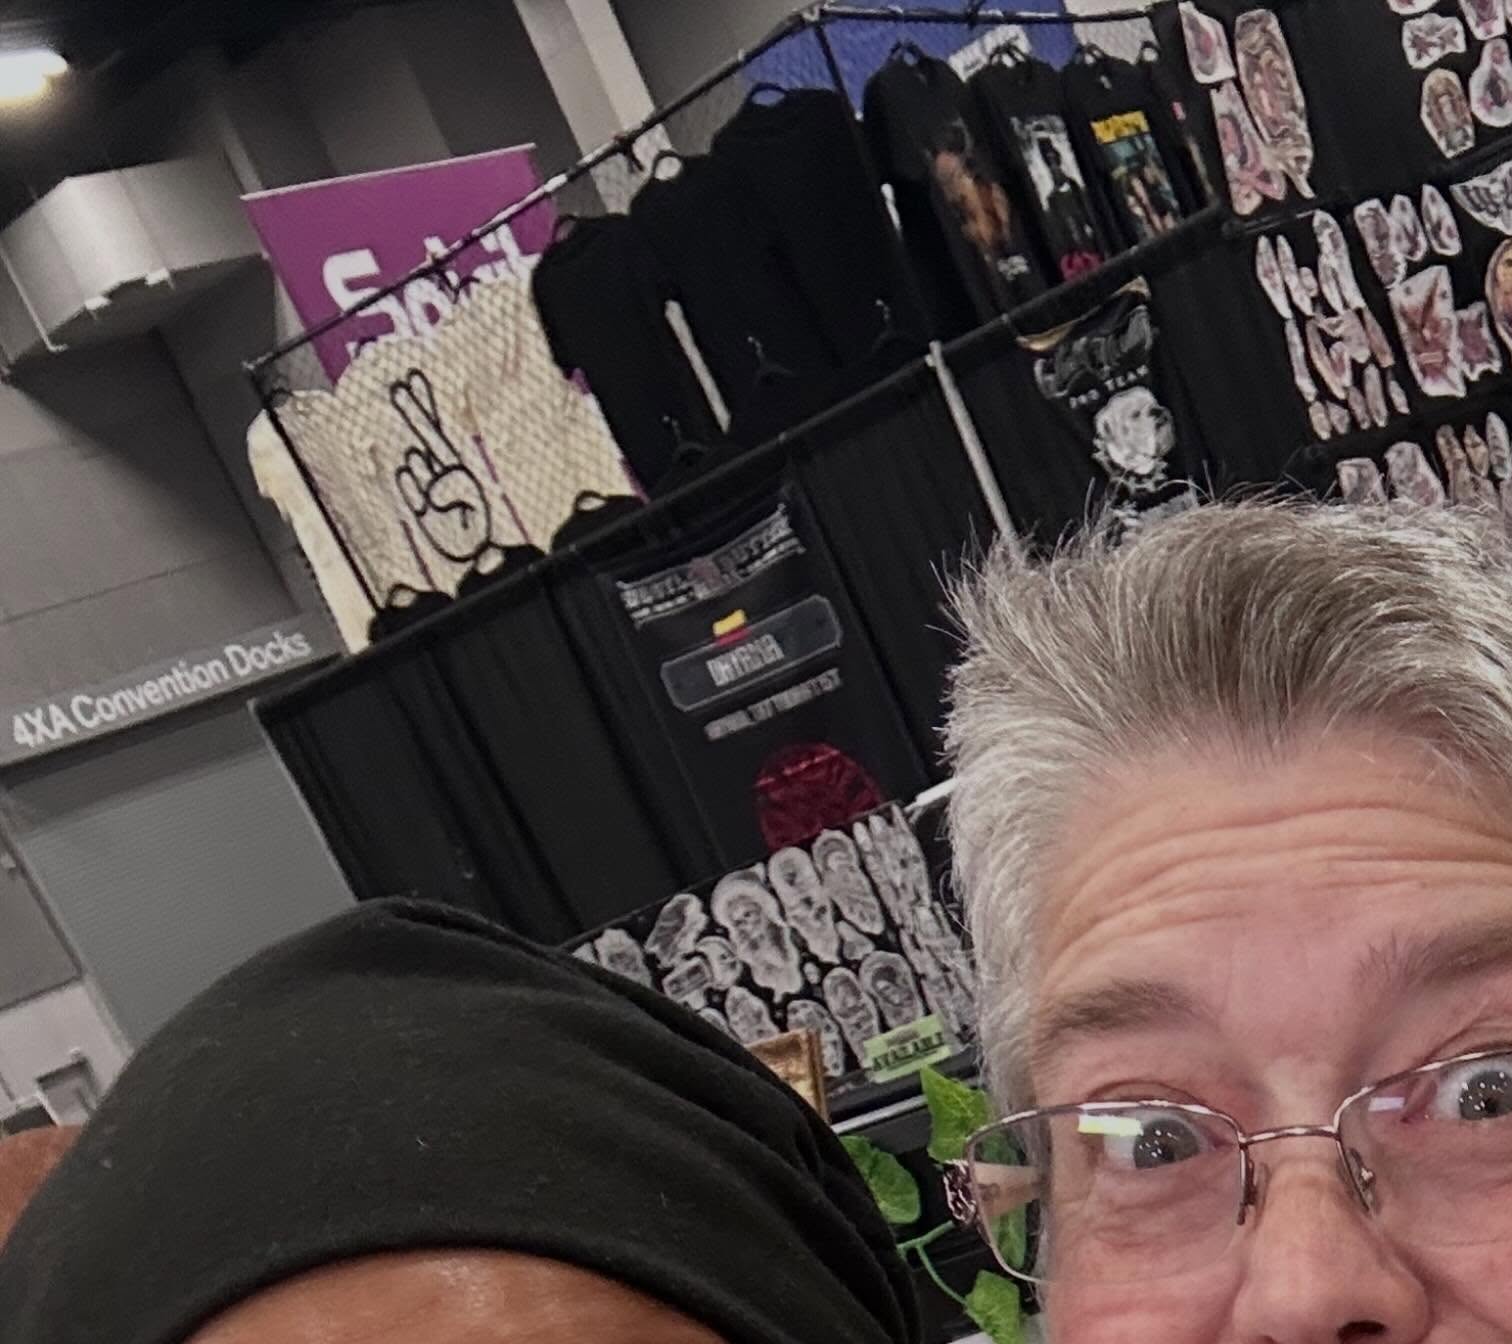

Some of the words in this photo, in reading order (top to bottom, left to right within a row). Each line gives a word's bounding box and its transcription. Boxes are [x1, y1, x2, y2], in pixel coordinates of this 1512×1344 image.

[12, 701, 79, 748] 4XA
[71, 660, 231, 729] Convention
[223, 631, 312, 677] Docks
